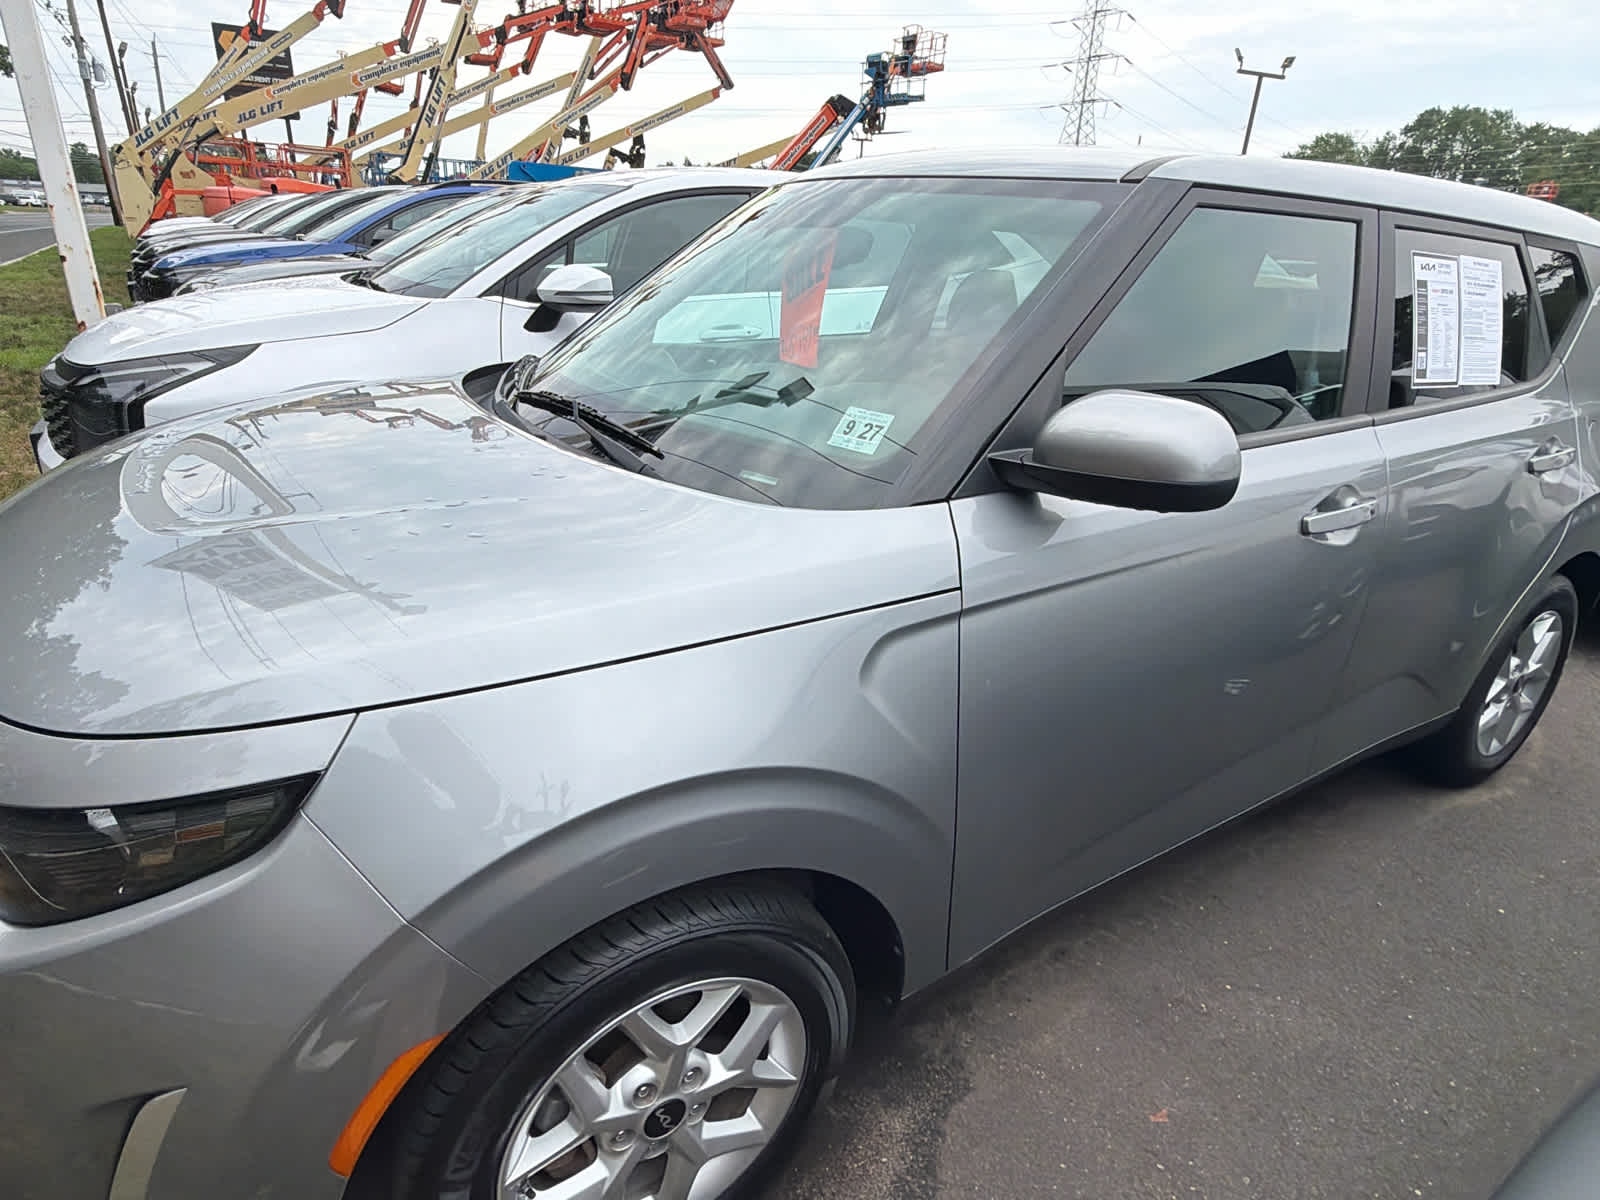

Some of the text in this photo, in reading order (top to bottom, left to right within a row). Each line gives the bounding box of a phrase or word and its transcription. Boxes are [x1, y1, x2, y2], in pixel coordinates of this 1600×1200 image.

[360, 47, 441, 82] complete equipment
[272, 77, 306, 95] complete
[307, 63, 345, 83] equipment
[425, 75, 446, 129] JLG LIFT
[496, 82, 556, 111] complete equipment
[237, 100, 284, 124] JLG LIFT
[630, 106, 683, 134] complete equipment
[134, 107, 180, 149] JLG LIFT
[358, 130, 375, 144] LIFT
[800, 116, 825, 146] equipment
[481, 164, 495, 179] JLG
[496, 151, 515, 169] LIFT
[561, 147, 591, 165] JLG LIFT
[1420, 262, 1437, 272] KIA
[842, 419, 887, 442] 9 27
